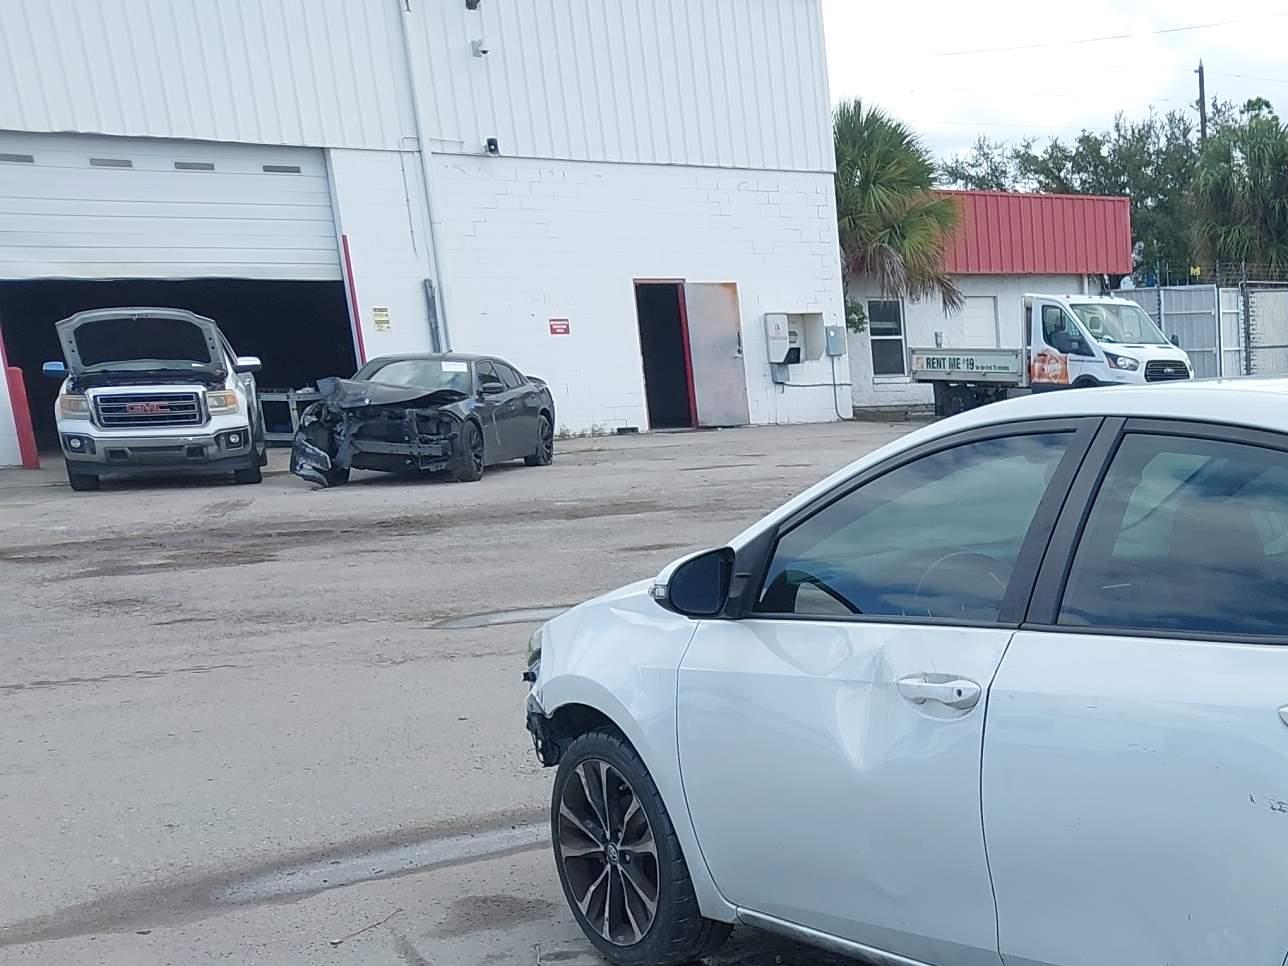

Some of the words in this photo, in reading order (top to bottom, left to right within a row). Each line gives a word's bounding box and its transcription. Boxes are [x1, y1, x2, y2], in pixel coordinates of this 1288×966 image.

[926, 357, 946, 370] RENT
[949, 357, 962, 370] ME
[127, 402, 170, 413] GMC
